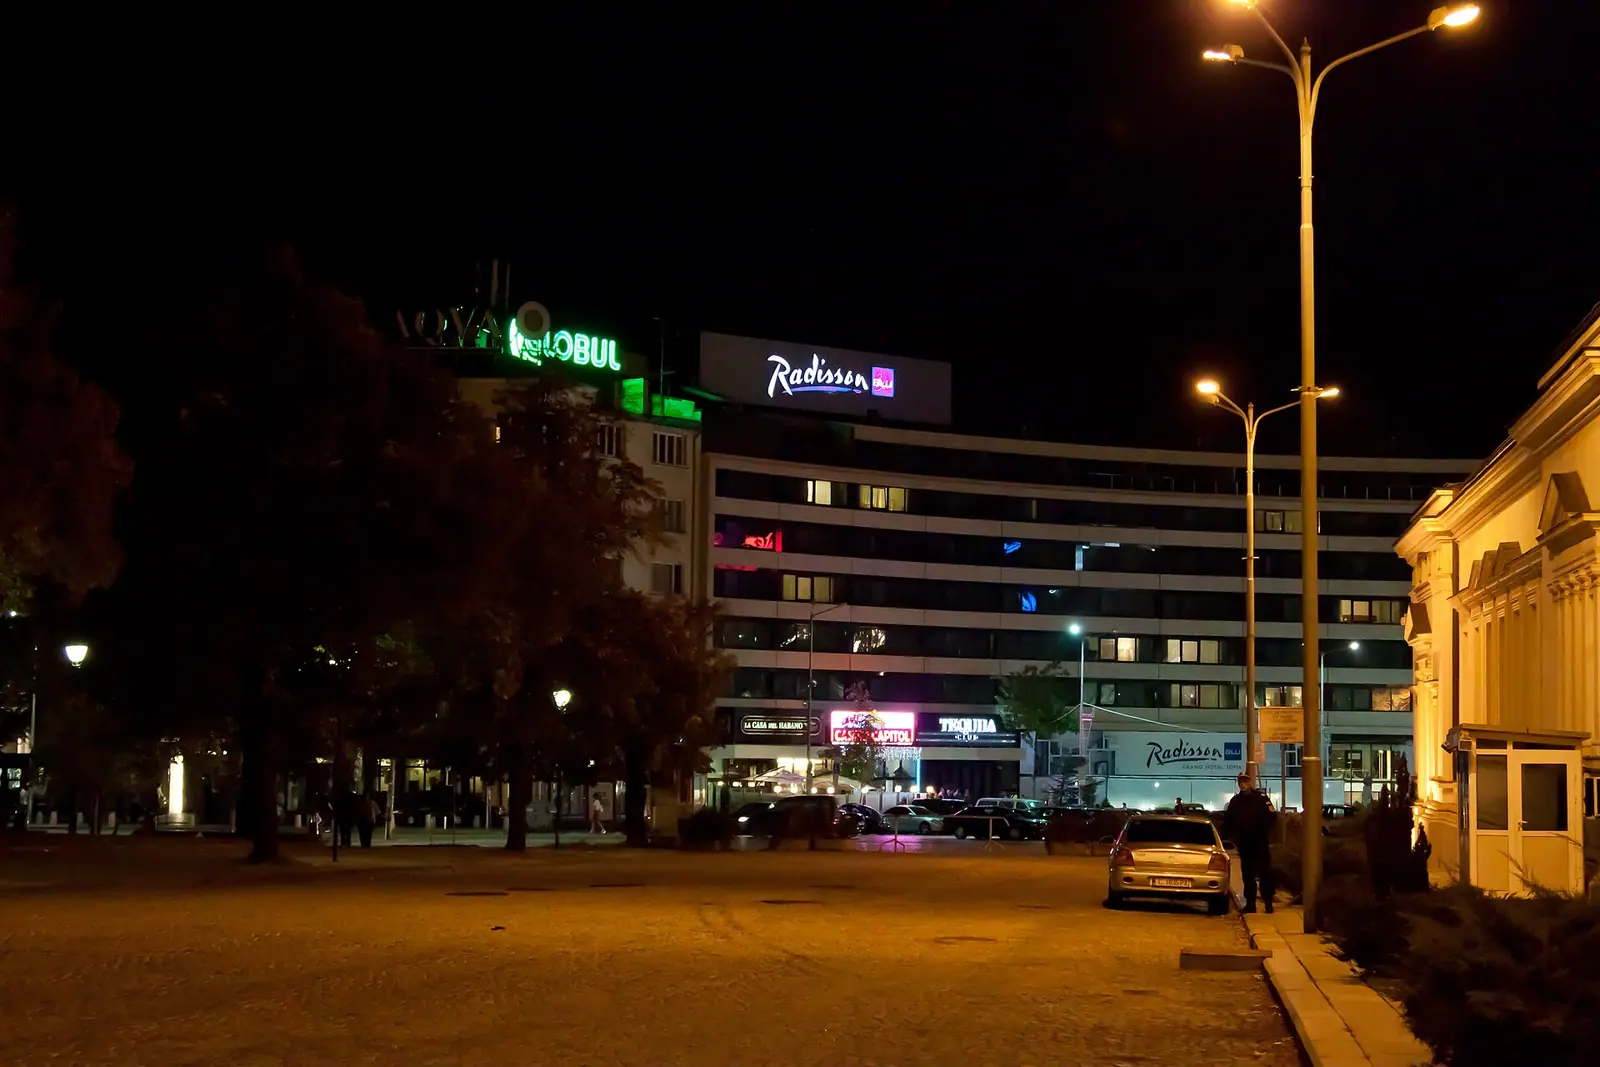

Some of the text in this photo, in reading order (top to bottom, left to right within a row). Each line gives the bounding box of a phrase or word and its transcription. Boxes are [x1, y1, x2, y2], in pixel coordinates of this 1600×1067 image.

[767, 353, 869, 398] Radisson
[752, 721, 767, 729] CASA
[778, 722, 803, 730] HABANO
[938, 718, 997, 733] TEQUILA
[872, 728, 911, 742] CAPITOL
[1146, 738, 1222, 768] Radisson
